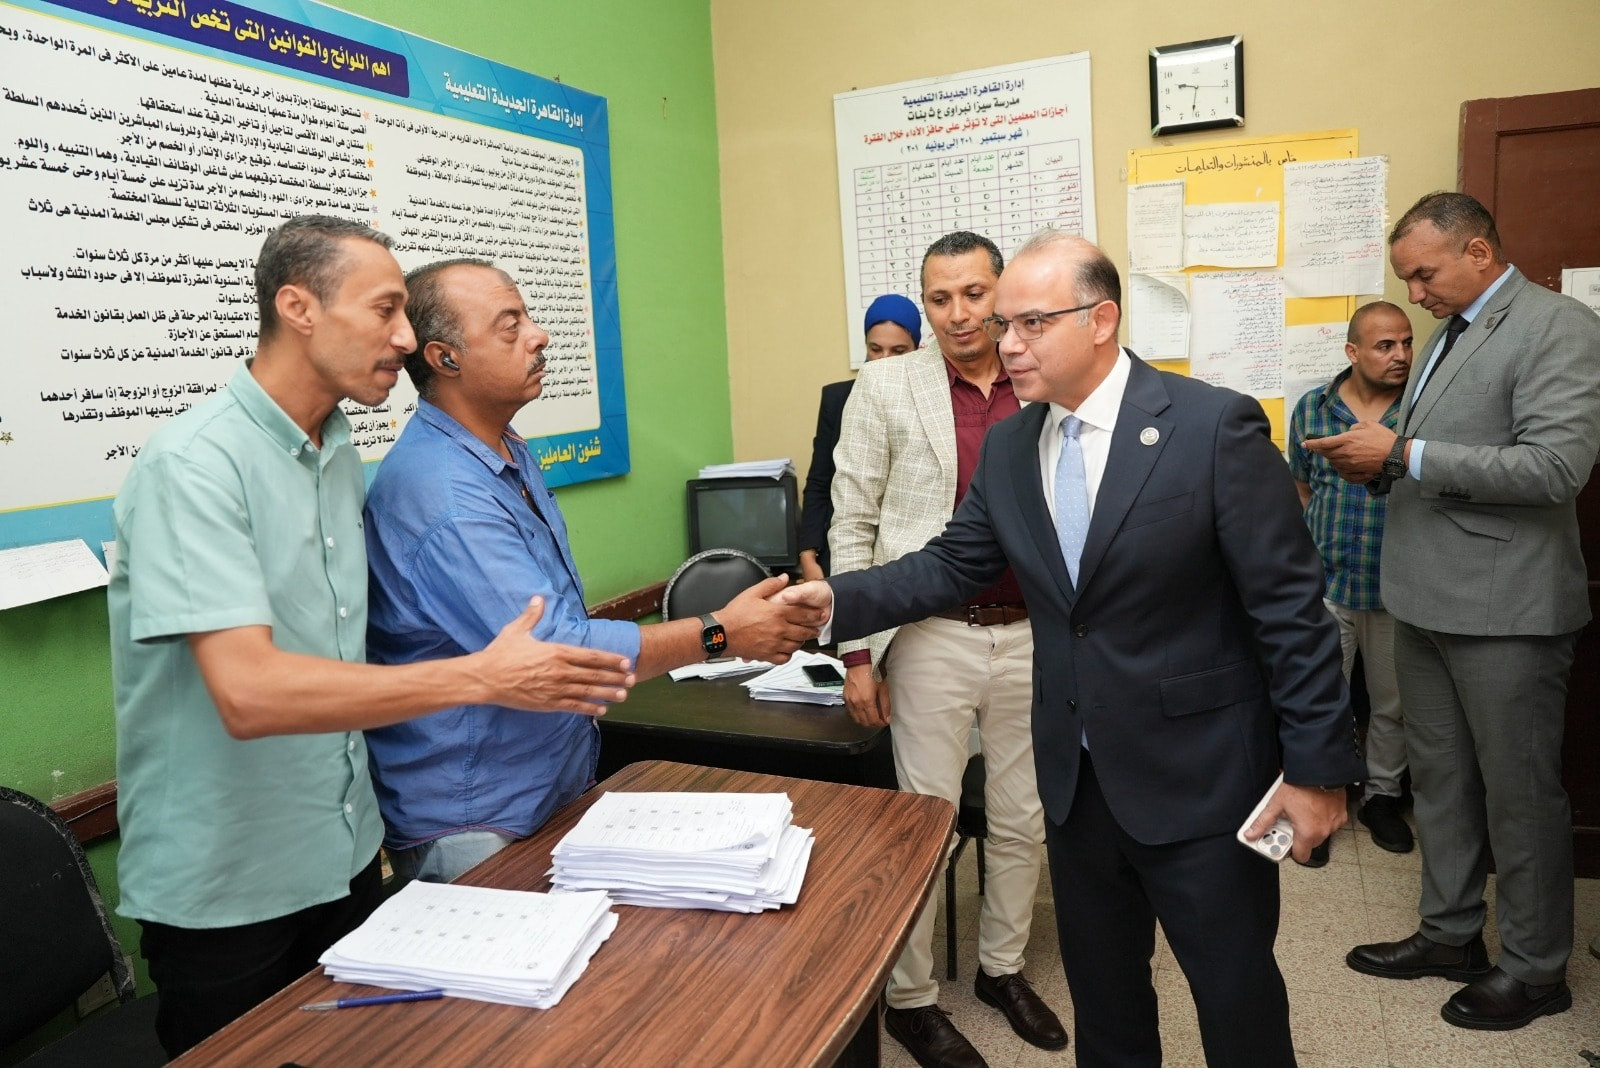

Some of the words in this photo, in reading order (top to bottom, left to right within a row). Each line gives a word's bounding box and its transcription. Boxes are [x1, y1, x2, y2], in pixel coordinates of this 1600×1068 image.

[190, 8, 231, 32] تخص
[235, 11, 267, 41] التى
[268, 26, 330, 63] والقوانين
[329, 42, 370, 73] اللوائح
[371, 61, 392, 78] اهم
[444, 72, 491, 102] التعليمية
[972, 81, 1004, 99] القاهرة
[1008, 78, 1025, 92] إدارة
[492, 88, 530, 114] الجديدة
[902, 92, 938, 112] التعليمية
[938, 87, 972, 103] الجديدة
[992, 96, 1020, 109] مدرسة
[531, 98, 563, 121] القاهرة
[927, 106, 936, 118] ث
[936, 107, 943, 120] ع
[943, 101, 972, 118] نبراوى
[973, 100, 992, 114] سيزا
[565, 108, 584, 132] إدارة
[907, 109, 927, 123] بنات
[981, 116, 988, 126] لا
[989, 114, 1006, 128] التى
[1007, 110, 1039, 125] المعلمين
[905, 126, 925, 138] الأداء
[925, 124, 944, 137] حافز
[945, 122, 960, 134] على
[961, 117, 980, 132] تؤثر
[863, 132, 887, 145] الفترة
[887, 129, 904, 143] خلال
[537, 443, 576, 470] العاملين
[578, 436, 600, 464] شئون
[712, 633, 724, 644] 60
